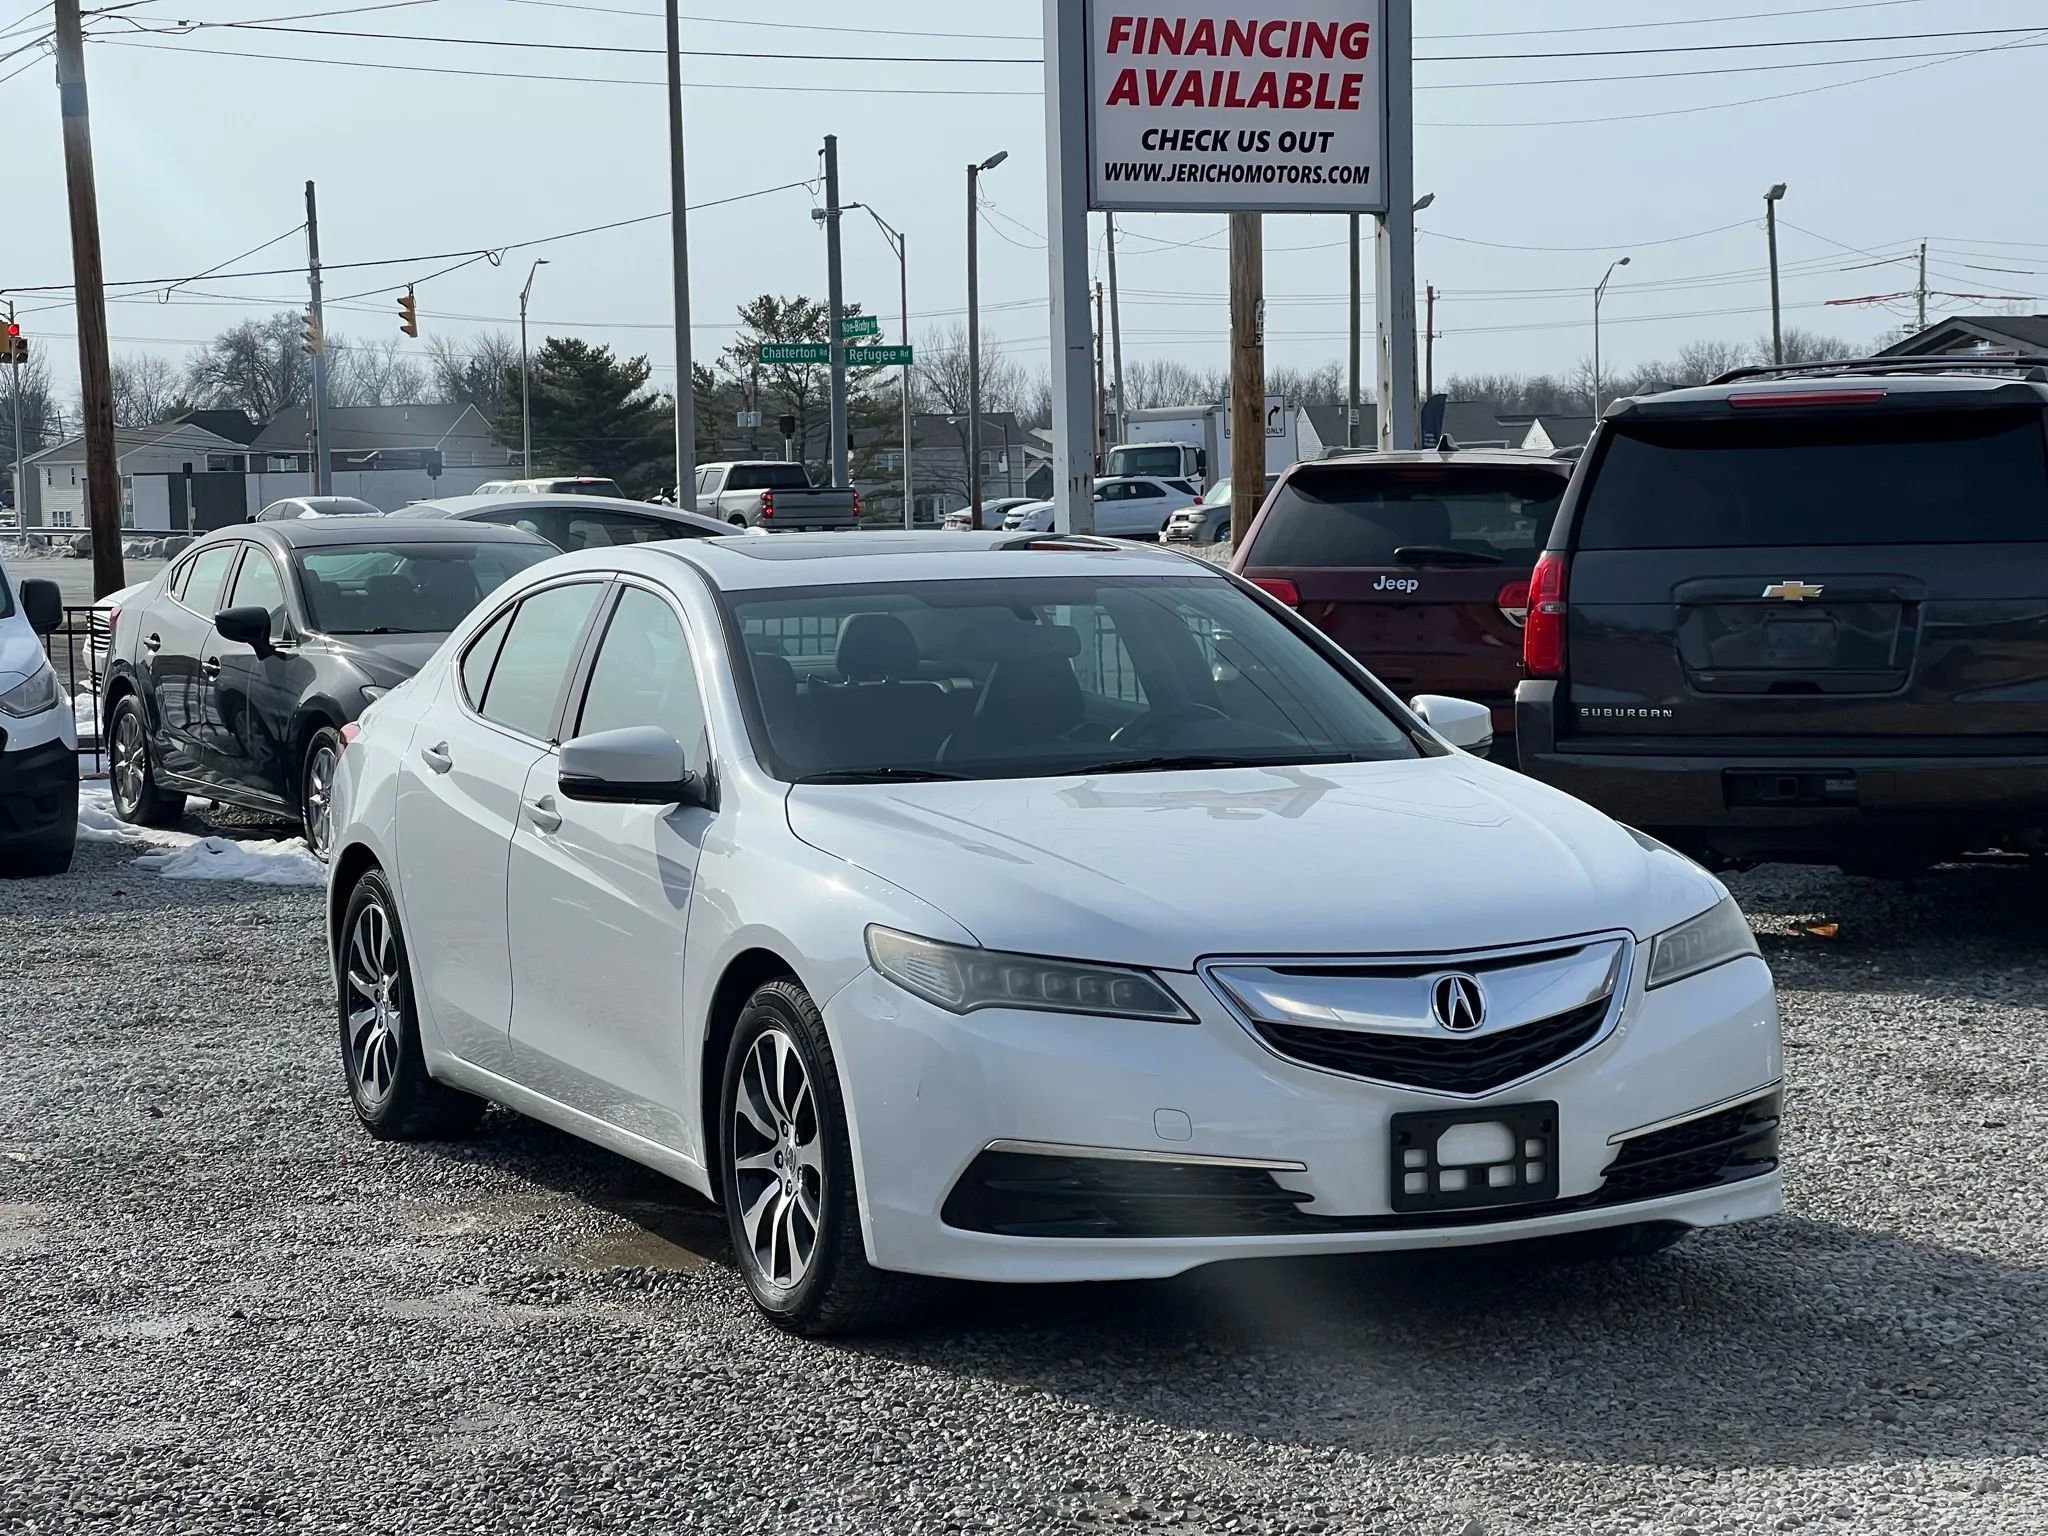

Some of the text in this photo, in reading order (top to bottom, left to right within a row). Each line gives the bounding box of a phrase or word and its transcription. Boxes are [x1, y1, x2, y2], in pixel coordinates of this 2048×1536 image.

[1106, 16, 1370, 60] FINANCING
[1105, 68, 1364, 110] AVAILABLE
[1141, 128, 1335, 153] CHECK US OUT
[1104, 162, 1370, 185] WWW.JERICHOMOTORS.COM
[761, 346, 828, 360] Chatterton Rd
[849, 349, 909, 364] Refugee Rd
[1266, 427, 1284, 435] ONLY
[1373, 575, 1419, 593] Jeep
[1581, 708, 1673, 718] SUBURBAN
